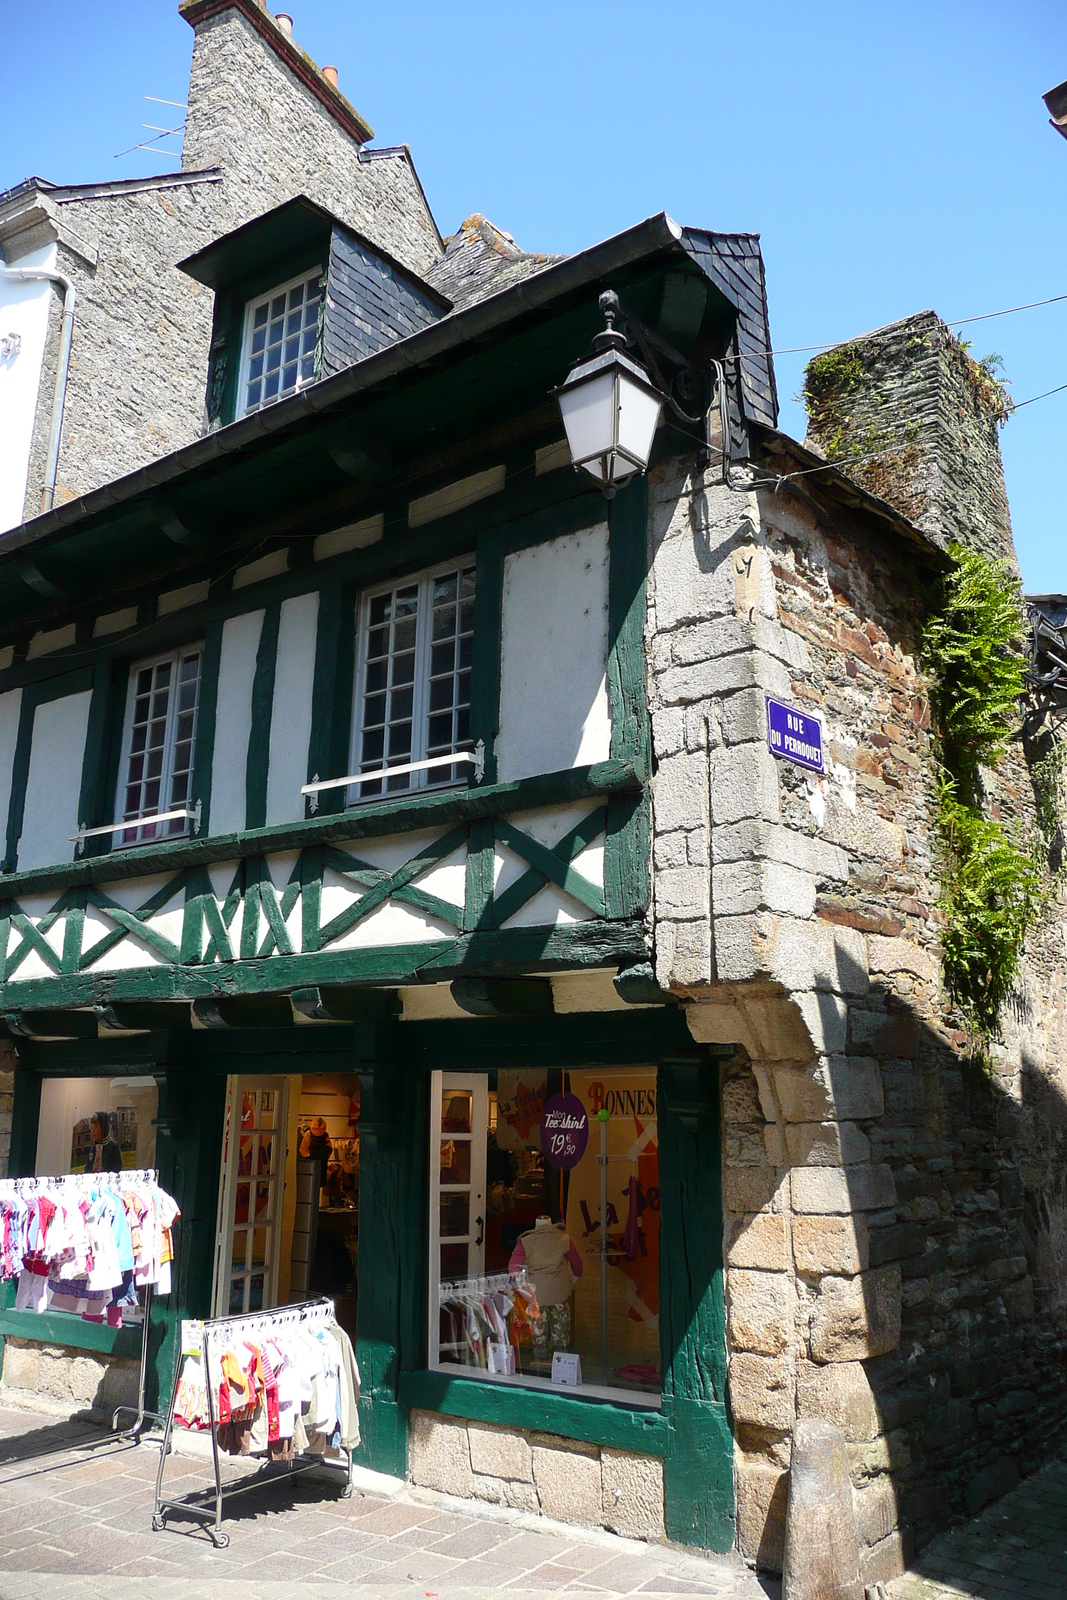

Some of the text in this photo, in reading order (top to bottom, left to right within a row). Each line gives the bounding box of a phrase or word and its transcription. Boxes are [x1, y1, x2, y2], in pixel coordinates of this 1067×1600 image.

[786, 713, 805, 735] RUE
[771, 729, 821, 764] DU PERROQUET
[545, 1113, 586, 1130] Tee-shirt
[579, 1199, 620, 1232] La
